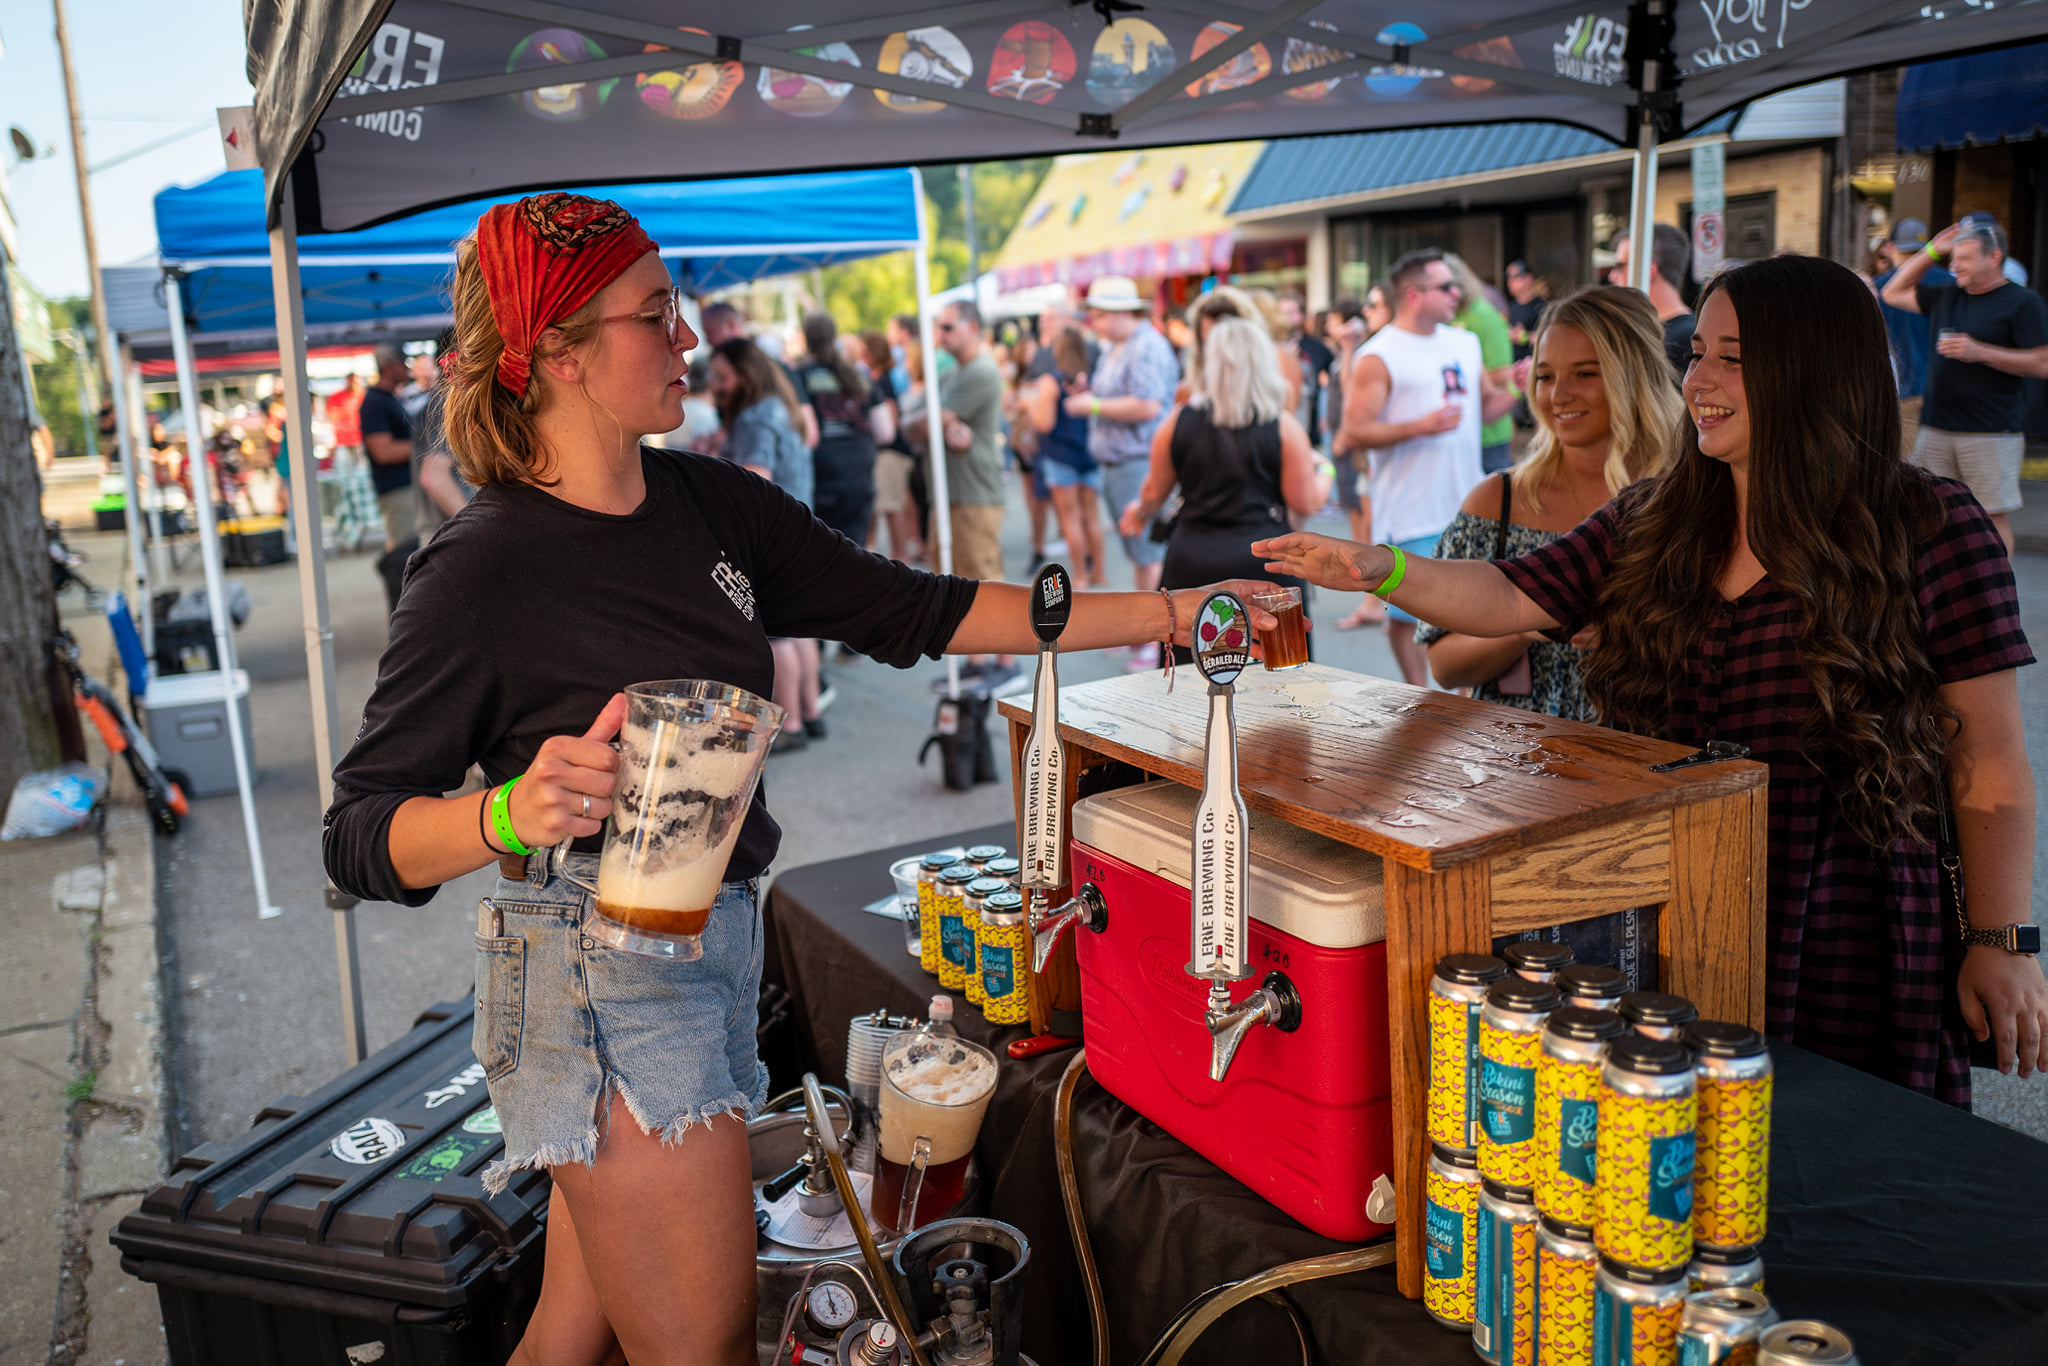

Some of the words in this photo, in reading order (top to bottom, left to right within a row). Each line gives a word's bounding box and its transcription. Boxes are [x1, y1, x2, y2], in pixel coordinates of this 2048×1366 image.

[1042, 572, 1063, 594] ERIE
[1044, 586, 1064, 601] BREWING
[1044, 594, 1064, 609] COMPANY
[1203, 655, 1233, 670] DERAILED
[1233, 654, 1246, 664] ALE
[1028, 771, 1040, 837] BREWING
[1046, 772, 1058, 837] BREWING
[1027, 840, 1037, 870] ERIE
[1044, 841, 1055, 871] ERIE
[1202, 838, 1214, 916] BREWING
[1224, 840, 1235, 918] BREWING
[1202, 920, 1214, 956] ERIE
[1224, 922, 1234, 958] ERIE
[1626, 938, 1635, 960] ISLE
[1482, 1062, 1526, 1091] Bikini
[1480, 1079, 1527, 1106] Season
